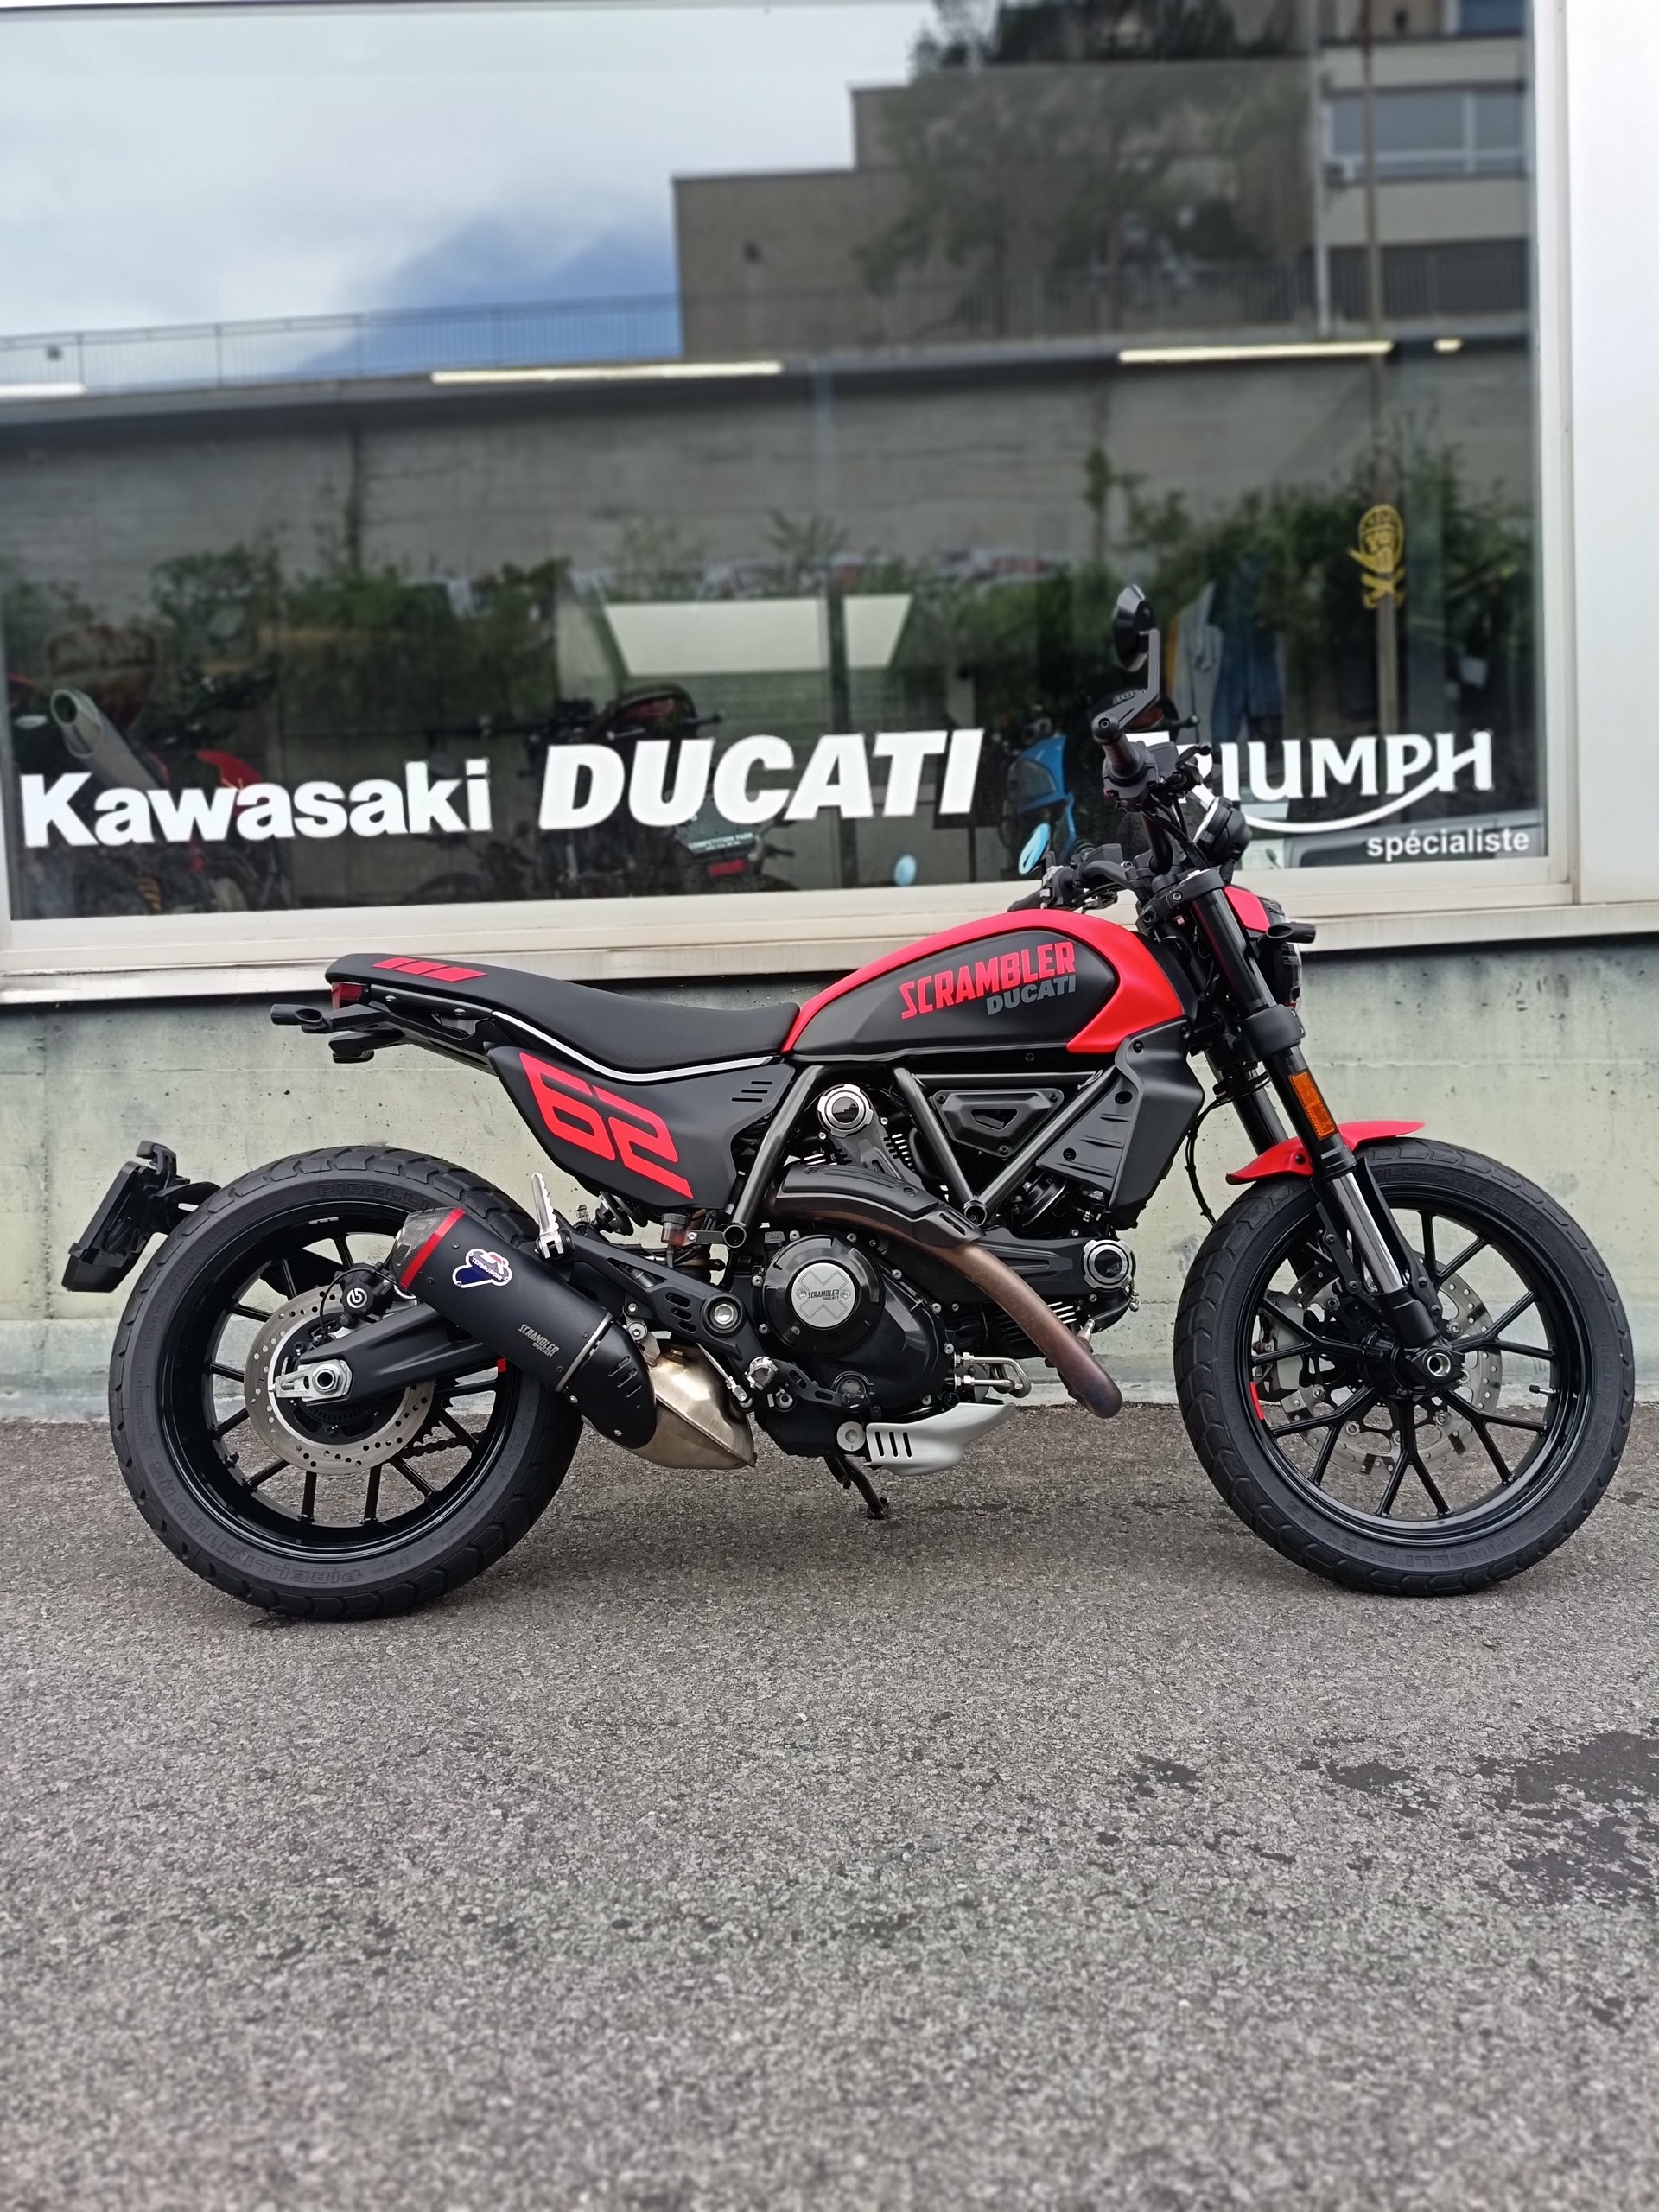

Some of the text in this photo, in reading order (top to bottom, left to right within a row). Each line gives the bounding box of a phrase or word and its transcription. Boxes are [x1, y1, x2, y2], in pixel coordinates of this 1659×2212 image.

[539, 728, 984, 830] DUCATI
[20, 759, 493, 847] Kawasaki
[1366, 830, 1530, 859] spécialiste
[899, 941, 1076, 1020] SCRAMBLER
[987, 975, 1076, 1015] DUCATI
[519, 1052, 694, 1199] 62
[316, 1183, 429, 1209] PIRELLI
[808, 1289, 839, 1299] SCRAMBLER
[518, 1323, 560, 1354] SCRAMBLER
[532, 1342, 553, 1357] DUCATI
[243, 1558, 361, 1583] PIRELLI
